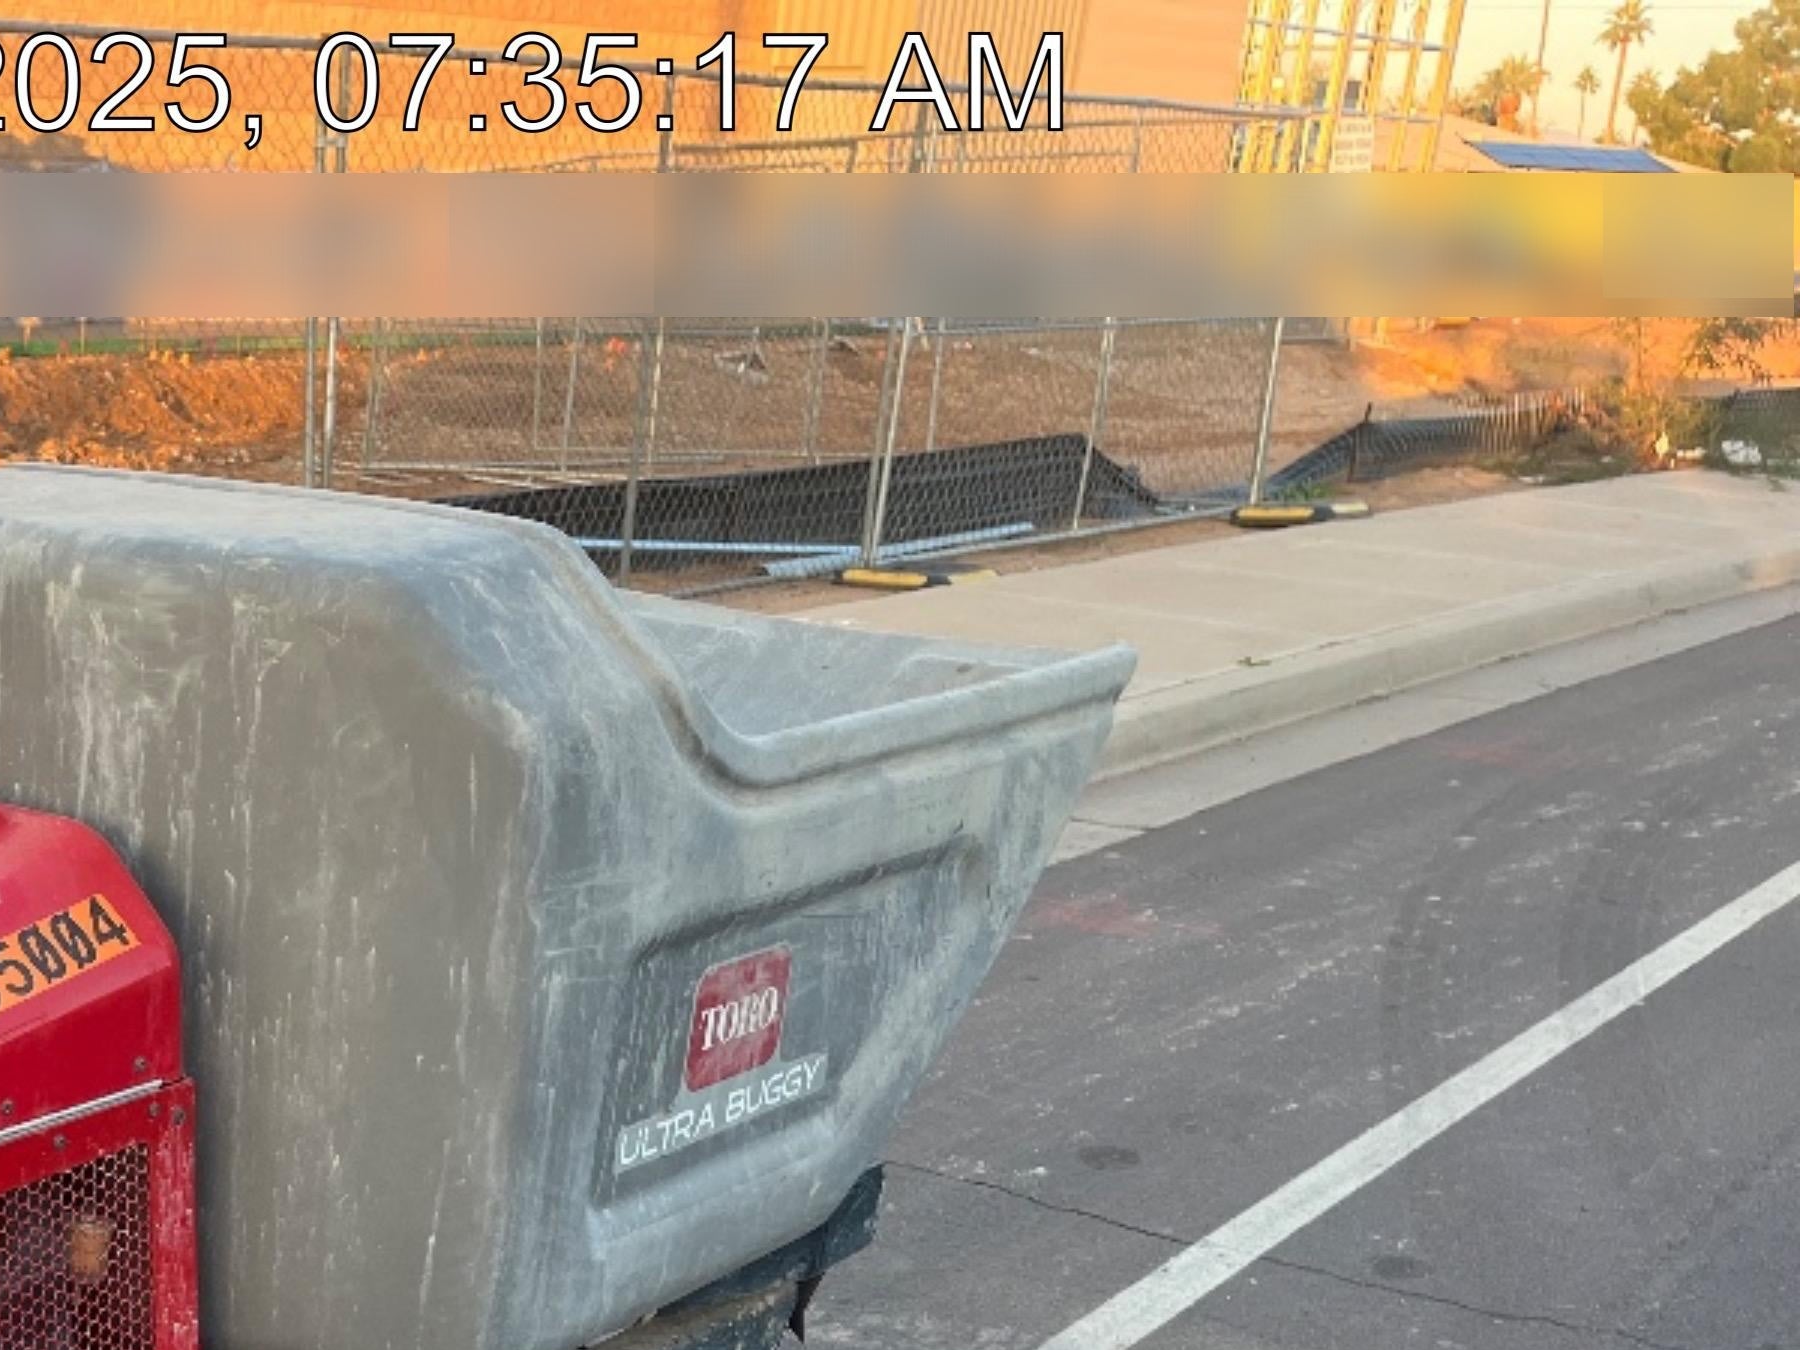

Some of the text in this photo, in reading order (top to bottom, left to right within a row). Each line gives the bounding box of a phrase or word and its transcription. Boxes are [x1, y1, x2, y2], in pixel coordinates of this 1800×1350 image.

[701, 985, 780, 1051] TORO
[618, 1059, 822, 1166] ULTRA BUGGY
